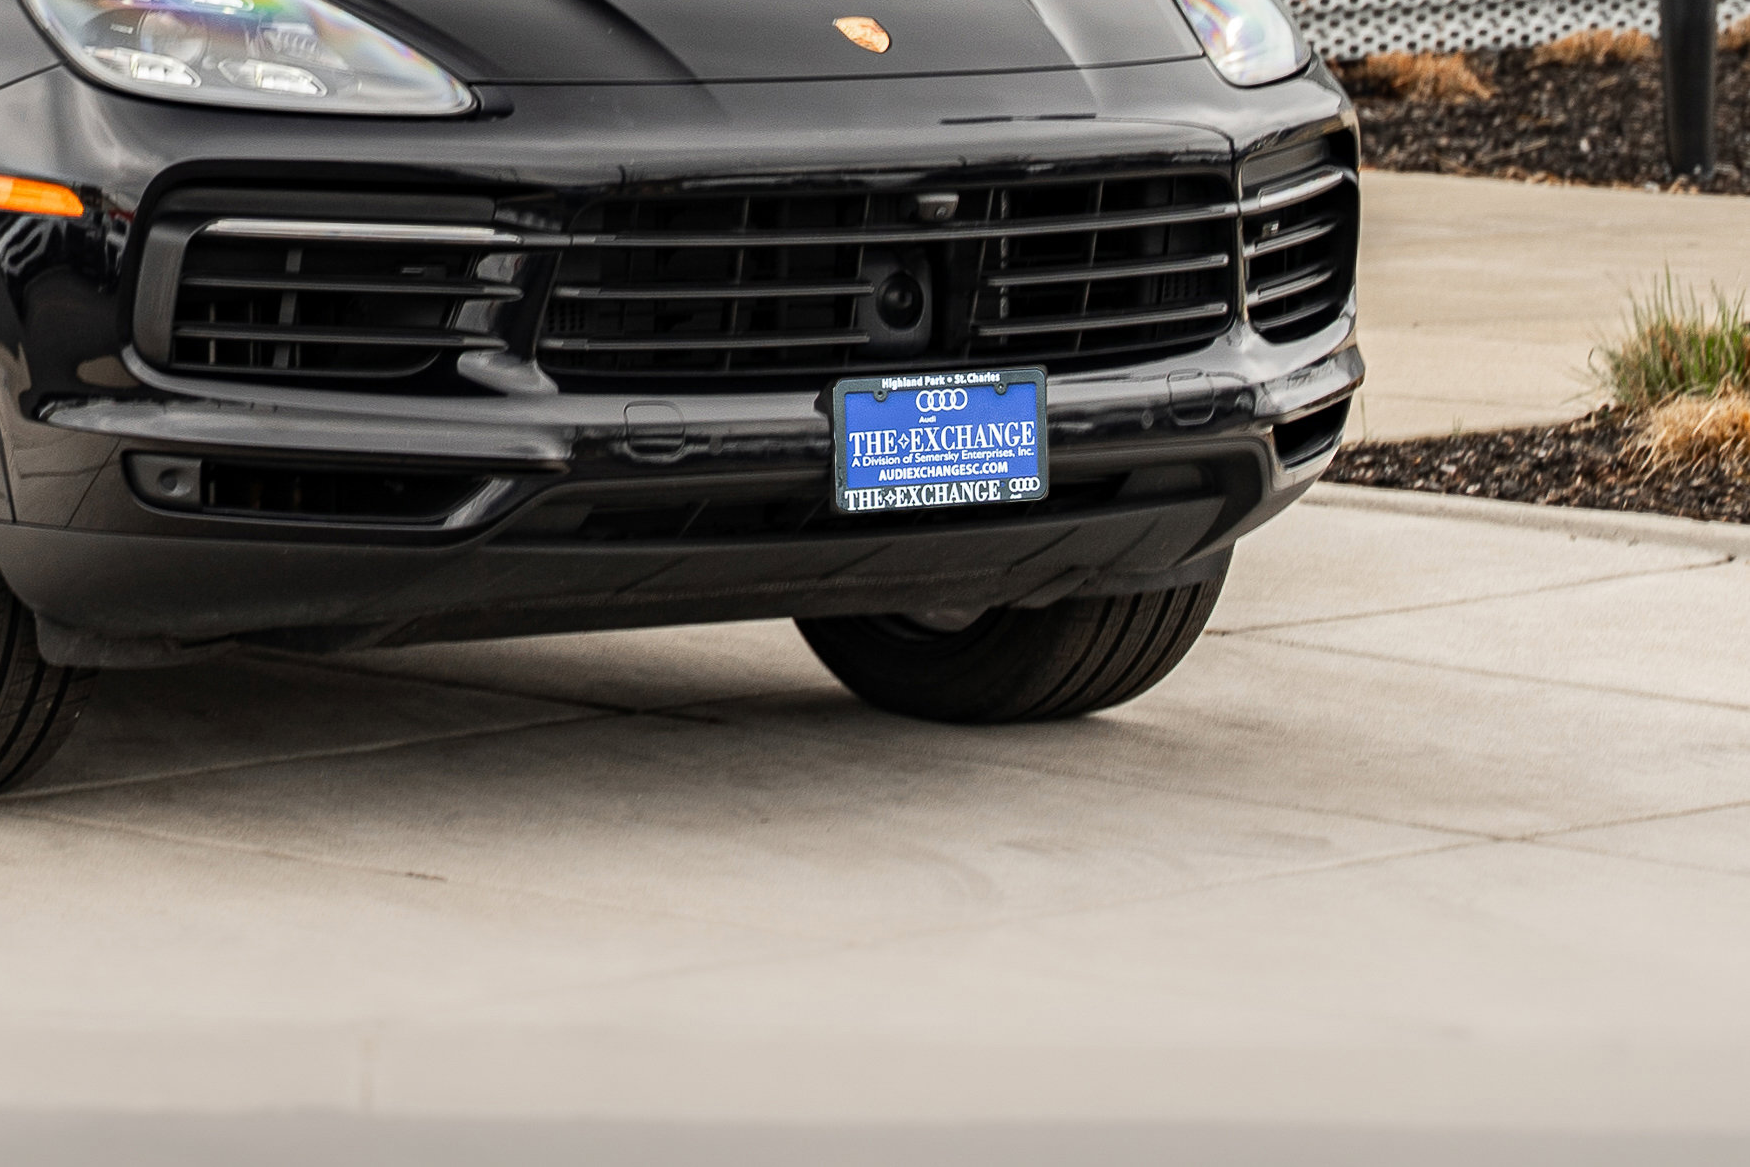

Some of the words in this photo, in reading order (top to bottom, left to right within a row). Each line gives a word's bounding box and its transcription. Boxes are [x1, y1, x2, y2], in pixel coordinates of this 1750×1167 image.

[882, 376, 923, 390] Highland
[924, 375, 945, 386] Park
[918, 415, 937, 424] Audi
[849, 430, 898, 456] THE
[909, 421, 1035, 453] EXCHANGE
[851, 457, 861, 468] A
[862, 455, 900, 467] Division
[902, 453, 913, 464] of
[914, 450, 959, 463] Semersky
[961, 448, 1015, 461] Enterprises,
[1017, 446, 1034, 456] Inc.
[878, 461, 1008, 481] AUDIEXCHANGESC.COM
[845, 490, 885, 511] THE
[894, 480, 1000, 508] EXCHANGE
